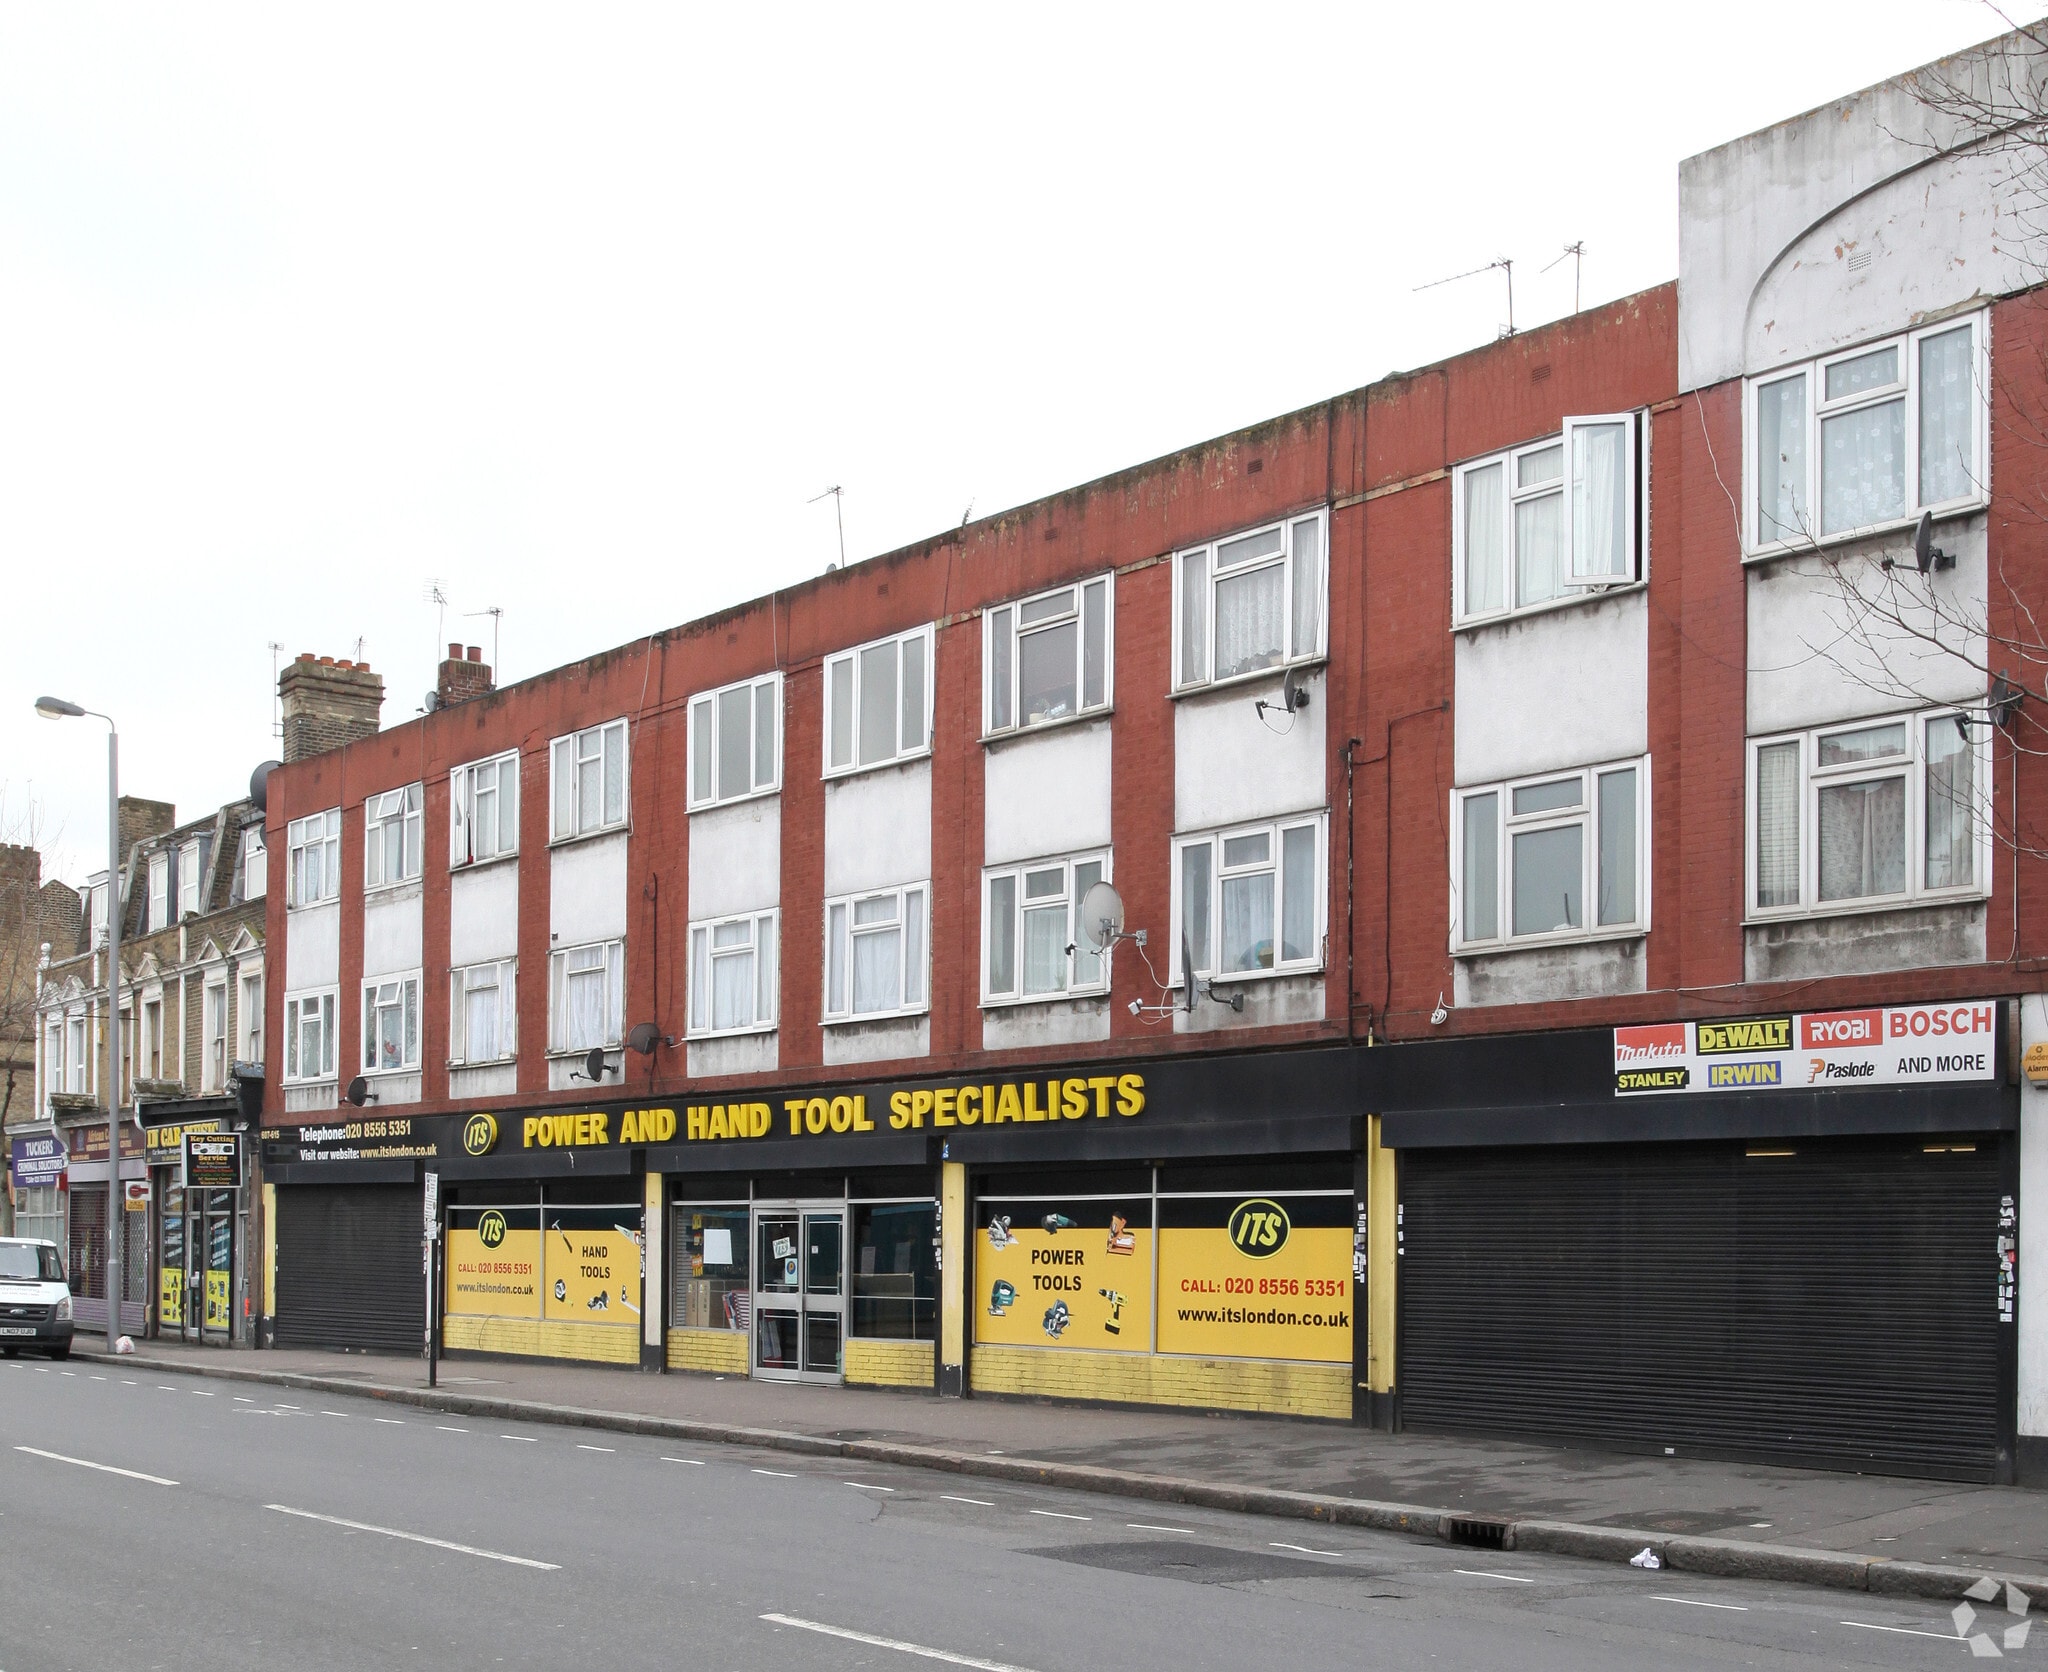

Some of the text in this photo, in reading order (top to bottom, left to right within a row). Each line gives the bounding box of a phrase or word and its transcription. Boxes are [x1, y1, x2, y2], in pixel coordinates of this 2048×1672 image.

[1810, 1018, 1870, 1041] RYOBI
[1890, 1006, 1992, 1038] BOSCH
[1826, 1061, 1875, 1078] Paslode
[1897, 1054, 1986, 1074] AND MORE
[1618, 1071, 1685, 1088] STANLEY
[1711, 1064, 1777, 1086] IRWIN
[524, 1074, 1145, 1148] POWER AND HAND TOOL SPECIALISTS
[364, 1122, 387, 1137] 8556
[389, 1120, 411, 1136] 5351
[468, 1122, 488, 1148] ITS
[26, 1140, 53, 1156] TUCKERS
[300, 1144, 437, 1160] Visit our website: www.itslondon.co.uk
[18, 1159, 62, 1172] CRIMINAL SOLICITORS
[482, 1218, 503, 1242] ITS
[1237, 1212, 1282, 1246] ITS
[582, 1246, 608, 1258] HAND
[1032, 1250, 1084, 1265] POWER
[458, 1263, 532, 1275] CALL: 020 8556 5351
[580, 1266, 610, 1279] TOOLS
[456, 1282, 534, 1295] www.itslondon.co.uk
[1033, 1275, 1082, 1291] TOOLS
[1181, 1277, 1345, 1297] CALL: 020 8556 5351
[1178, 1307, 1349, 1327] www.itslondon.co.uk
